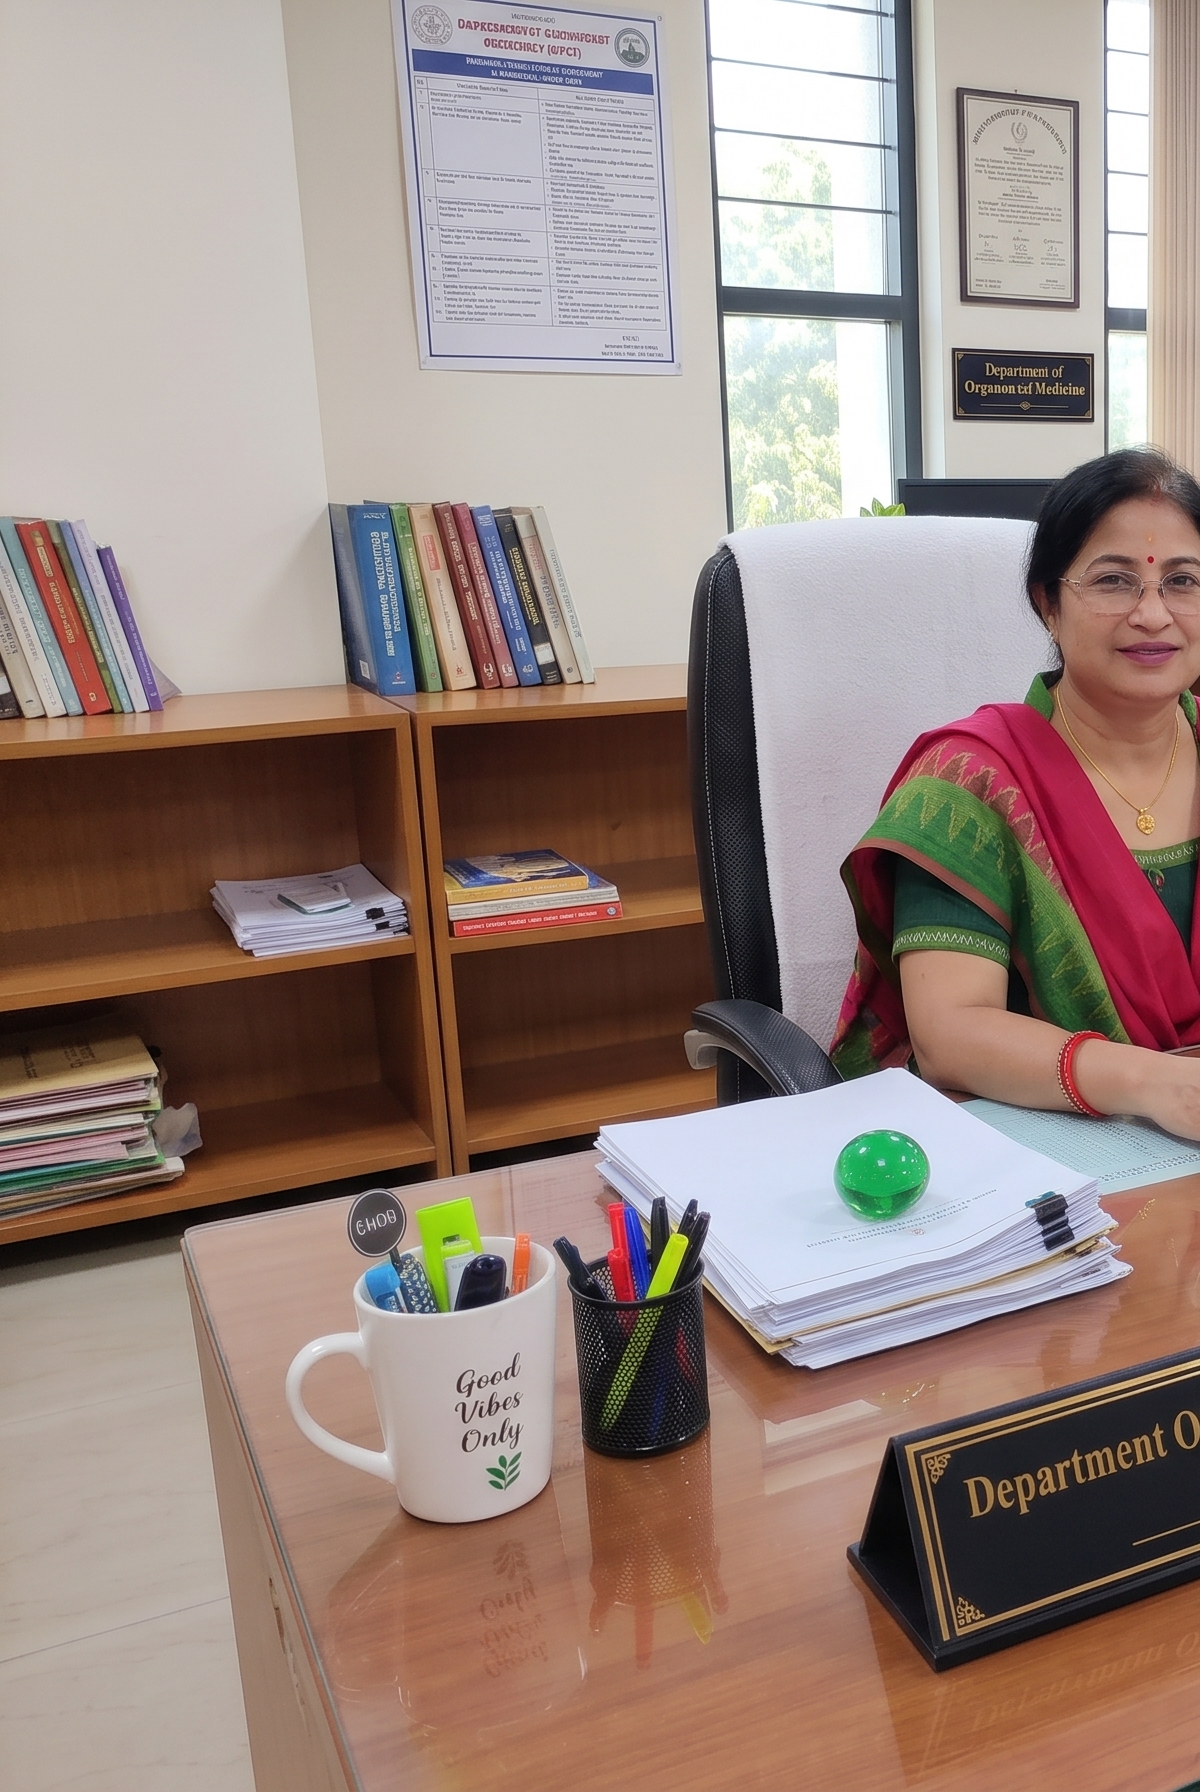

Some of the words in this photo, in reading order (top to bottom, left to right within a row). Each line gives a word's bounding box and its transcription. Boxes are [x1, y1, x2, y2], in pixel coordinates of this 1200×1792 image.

[965, 380, 1015, 396] Organon
[1035, 382, 1085, 396] Medicine
[1052, 366, 1064, 378] of
[456, 1353, 521, 1398] Good
[455, 1392, 523, 1424] Vibes
[462, 1416, 523, 1452] Only
[963, 1423, 1168, 1518] Department
